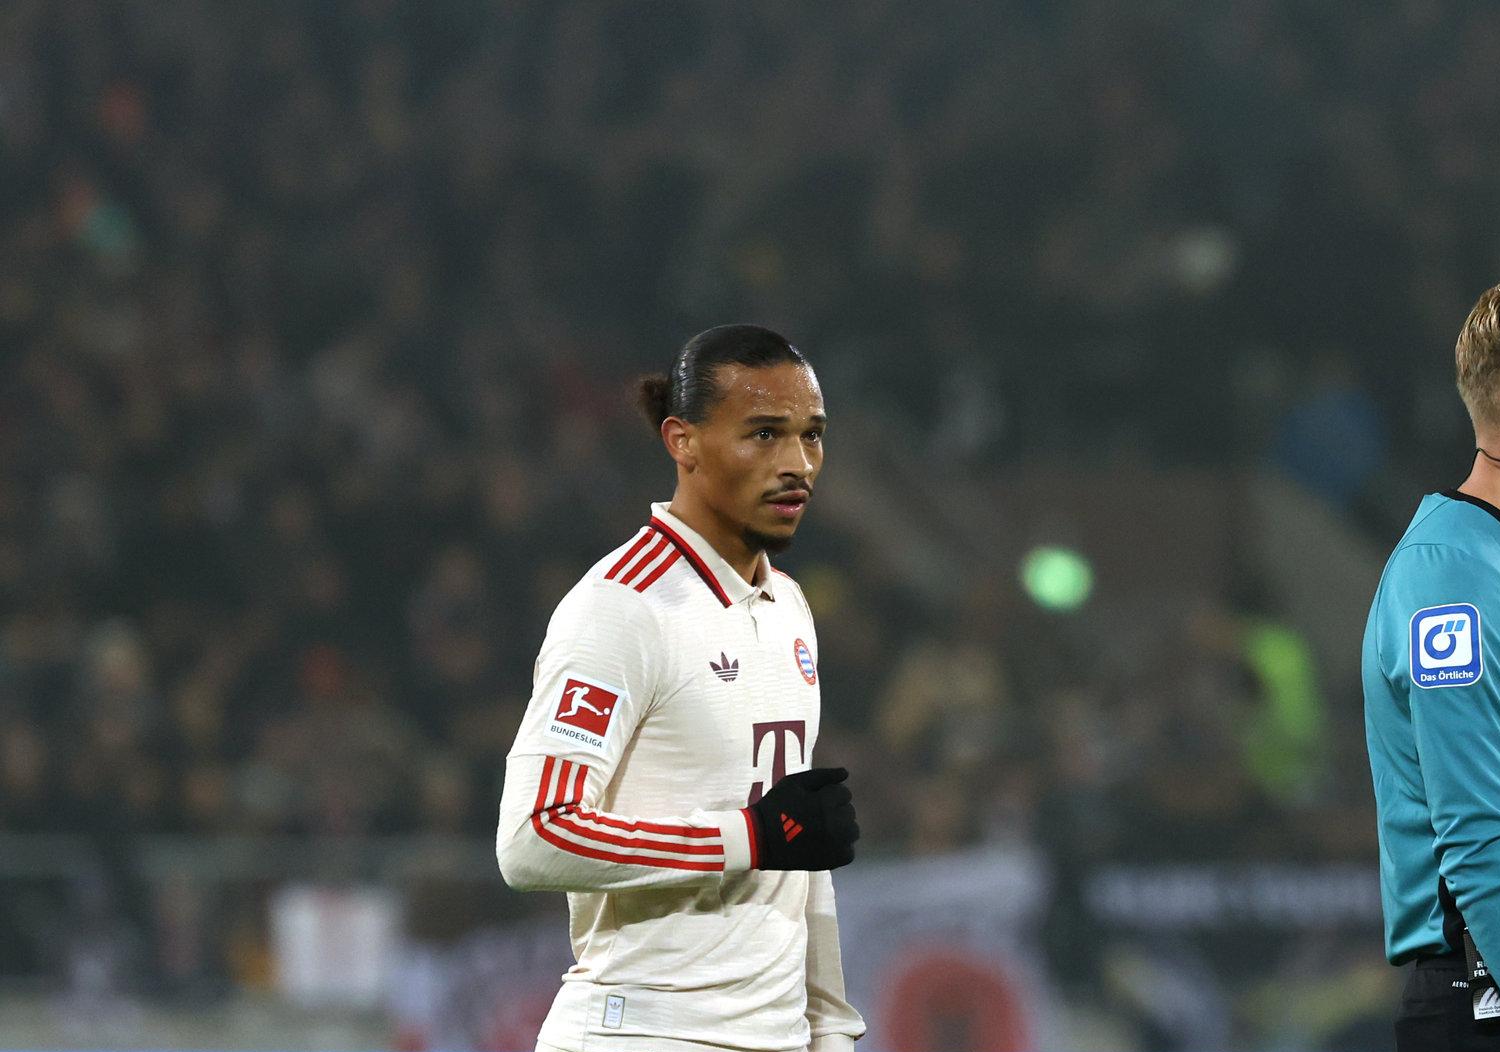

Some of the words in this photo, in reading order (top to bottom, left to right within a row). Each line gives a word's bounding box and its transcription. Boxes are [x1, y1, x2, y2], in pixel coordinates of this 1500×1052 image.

[1420, 673, 1437, 682] Das
[1438, 670, 1474, 681] Örtliche
[550, 724, 603, 749] BUNDESLIGA
